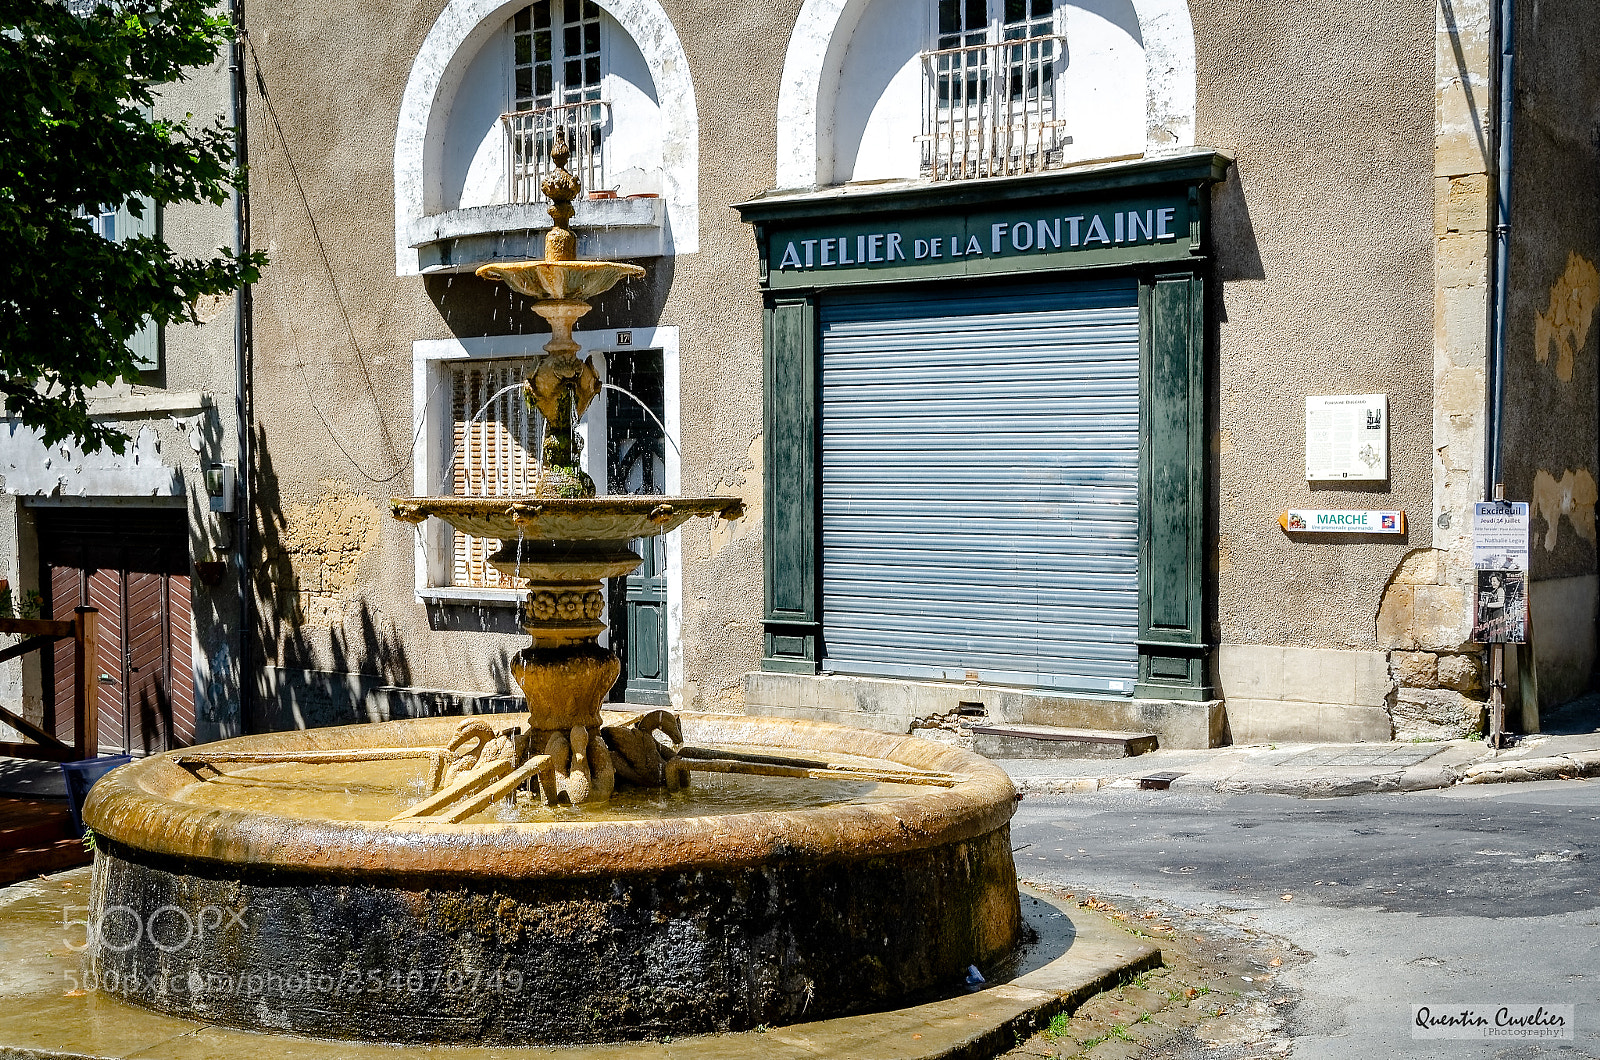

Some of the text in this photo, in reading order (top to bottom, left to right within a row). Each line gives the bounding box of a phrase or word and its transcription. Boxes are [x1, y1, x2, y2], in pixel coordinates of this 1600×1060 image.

[779, 207, 1175, 270] ATELIER DE LA FONTAINE
[620, 333, 630, 343] 17
[1481, 506, 1521, 515] Excideuil
[1317, 512, 1368, 525] MARCHÉ
